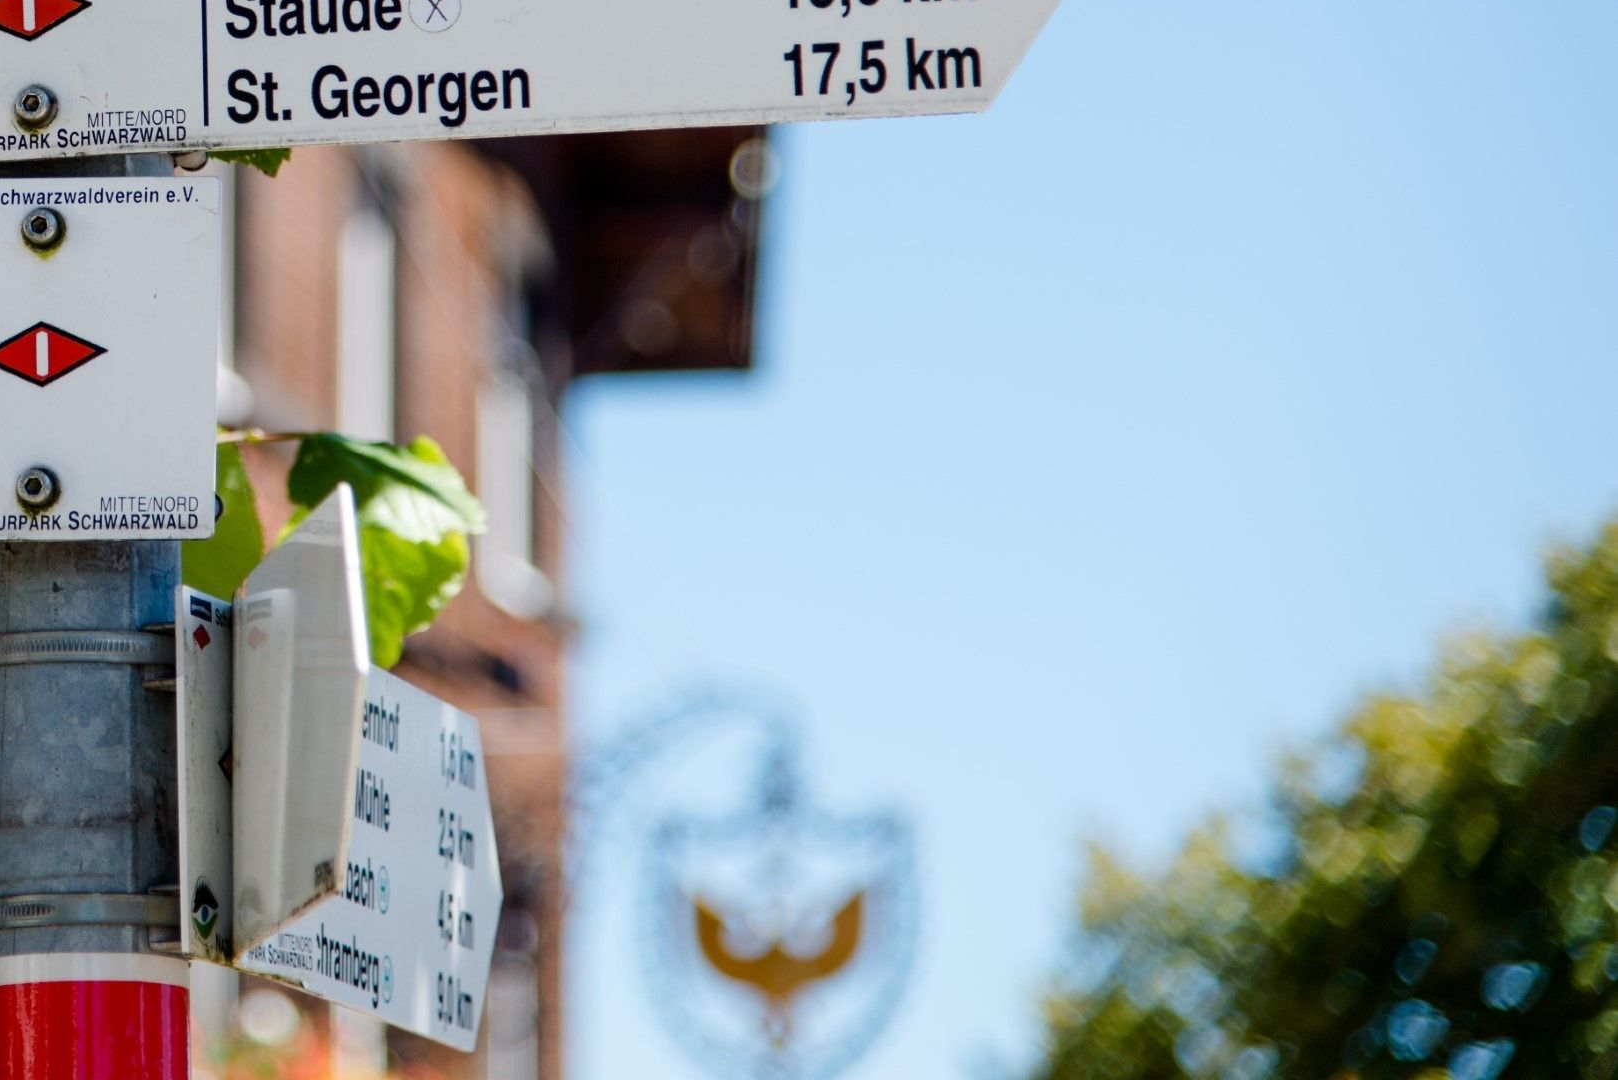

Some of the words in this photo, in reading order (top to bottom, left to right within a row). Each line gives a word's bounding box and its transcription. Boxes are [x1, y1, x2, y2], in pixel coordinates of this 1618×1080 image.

[784, 40, 886, 106] 17,5
[906, 37, 981, 90] km
[227, 69, 292, 123] St.
[312, 64, 530, 127] Georgen
[87, 109, 186, 128] MITTE/NORD
[57, 125, 186, 148] SCHWARZWALD
[166, 186, 198, 203] e.V.
[100, 496, 199, 512] MITTE/NORD
[67, 510, 199, 531] SCHWARZWALD
